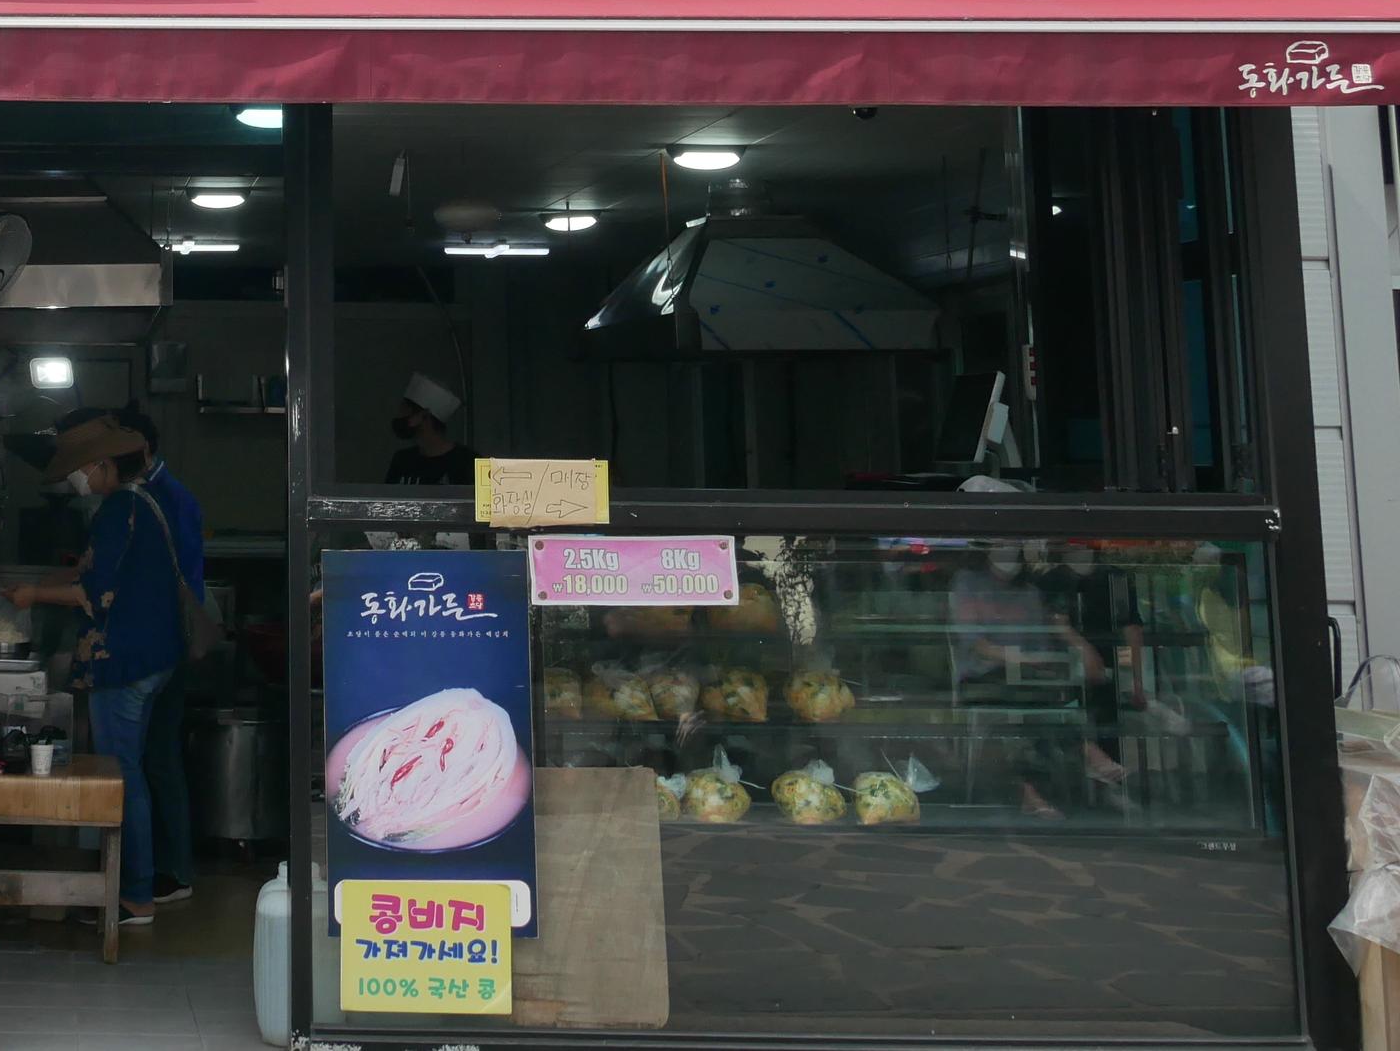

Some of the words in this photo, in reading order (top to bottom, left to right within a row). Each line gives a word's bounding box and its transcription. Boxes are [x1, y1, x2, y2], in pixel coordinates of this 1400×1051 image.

[1238, 62, 1385, 98] 동화가든
[550, 469, 592, 491] 매장
[492, 489, 533, 515] 화장실
[563, 549, 620, 570] 2.5Kg
[660, 549, 701, 571] 8Kg
[361, 591, 498, 624] 동화가든
[369, 894, 486, 935] 콩비지
[356, 939, 498, 964] 가져가세요!
[358, 978, 419, 998] 100%
[428, 978, 470, 999] 국산
[478, 978, 496, 1000] 콩
